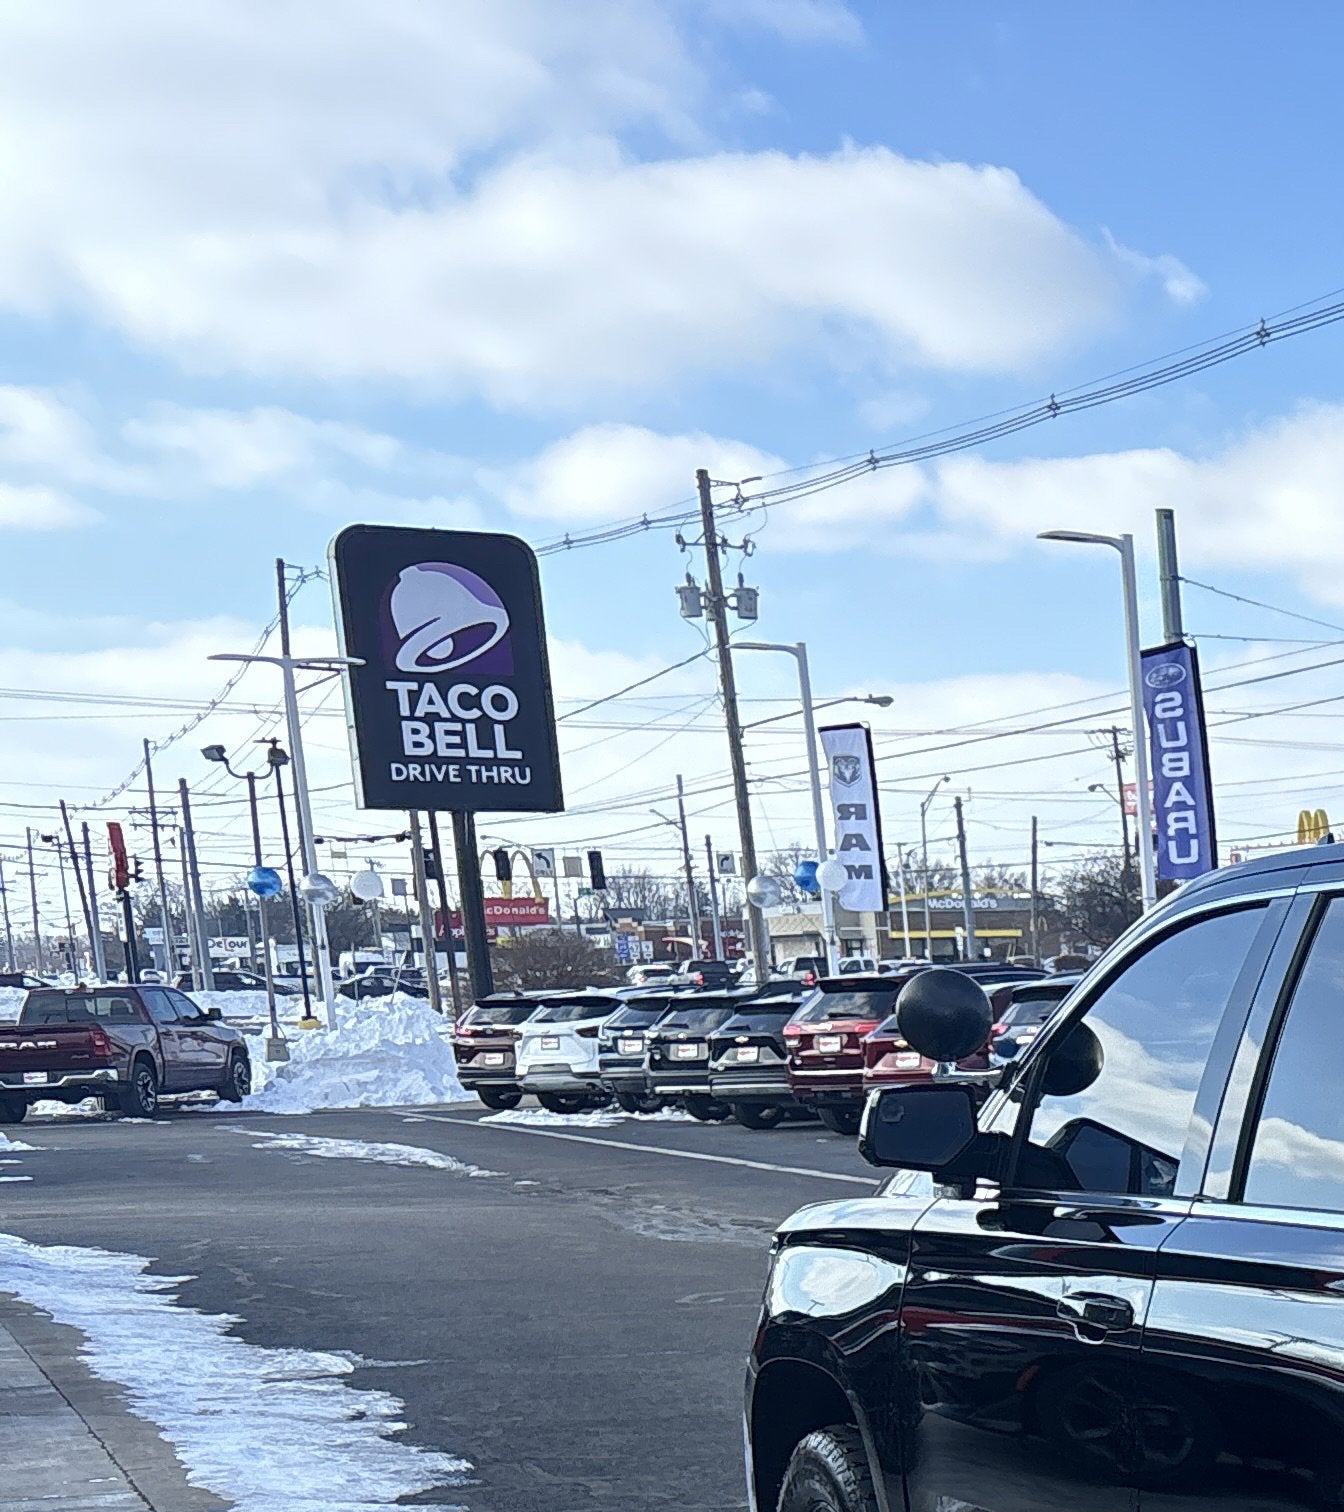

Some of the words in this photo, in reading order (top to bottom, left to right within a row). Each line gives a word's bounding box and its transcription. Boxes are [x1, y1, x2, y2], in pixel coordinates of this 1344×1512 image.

[385, 680, 519, 721] TACO
[401, 720, 523, 760] BELL
[390, 763, 462, 783] DRIVE
[466, 764, 531, 785] THRU
[485, 905, 546, 915] cDonald's
